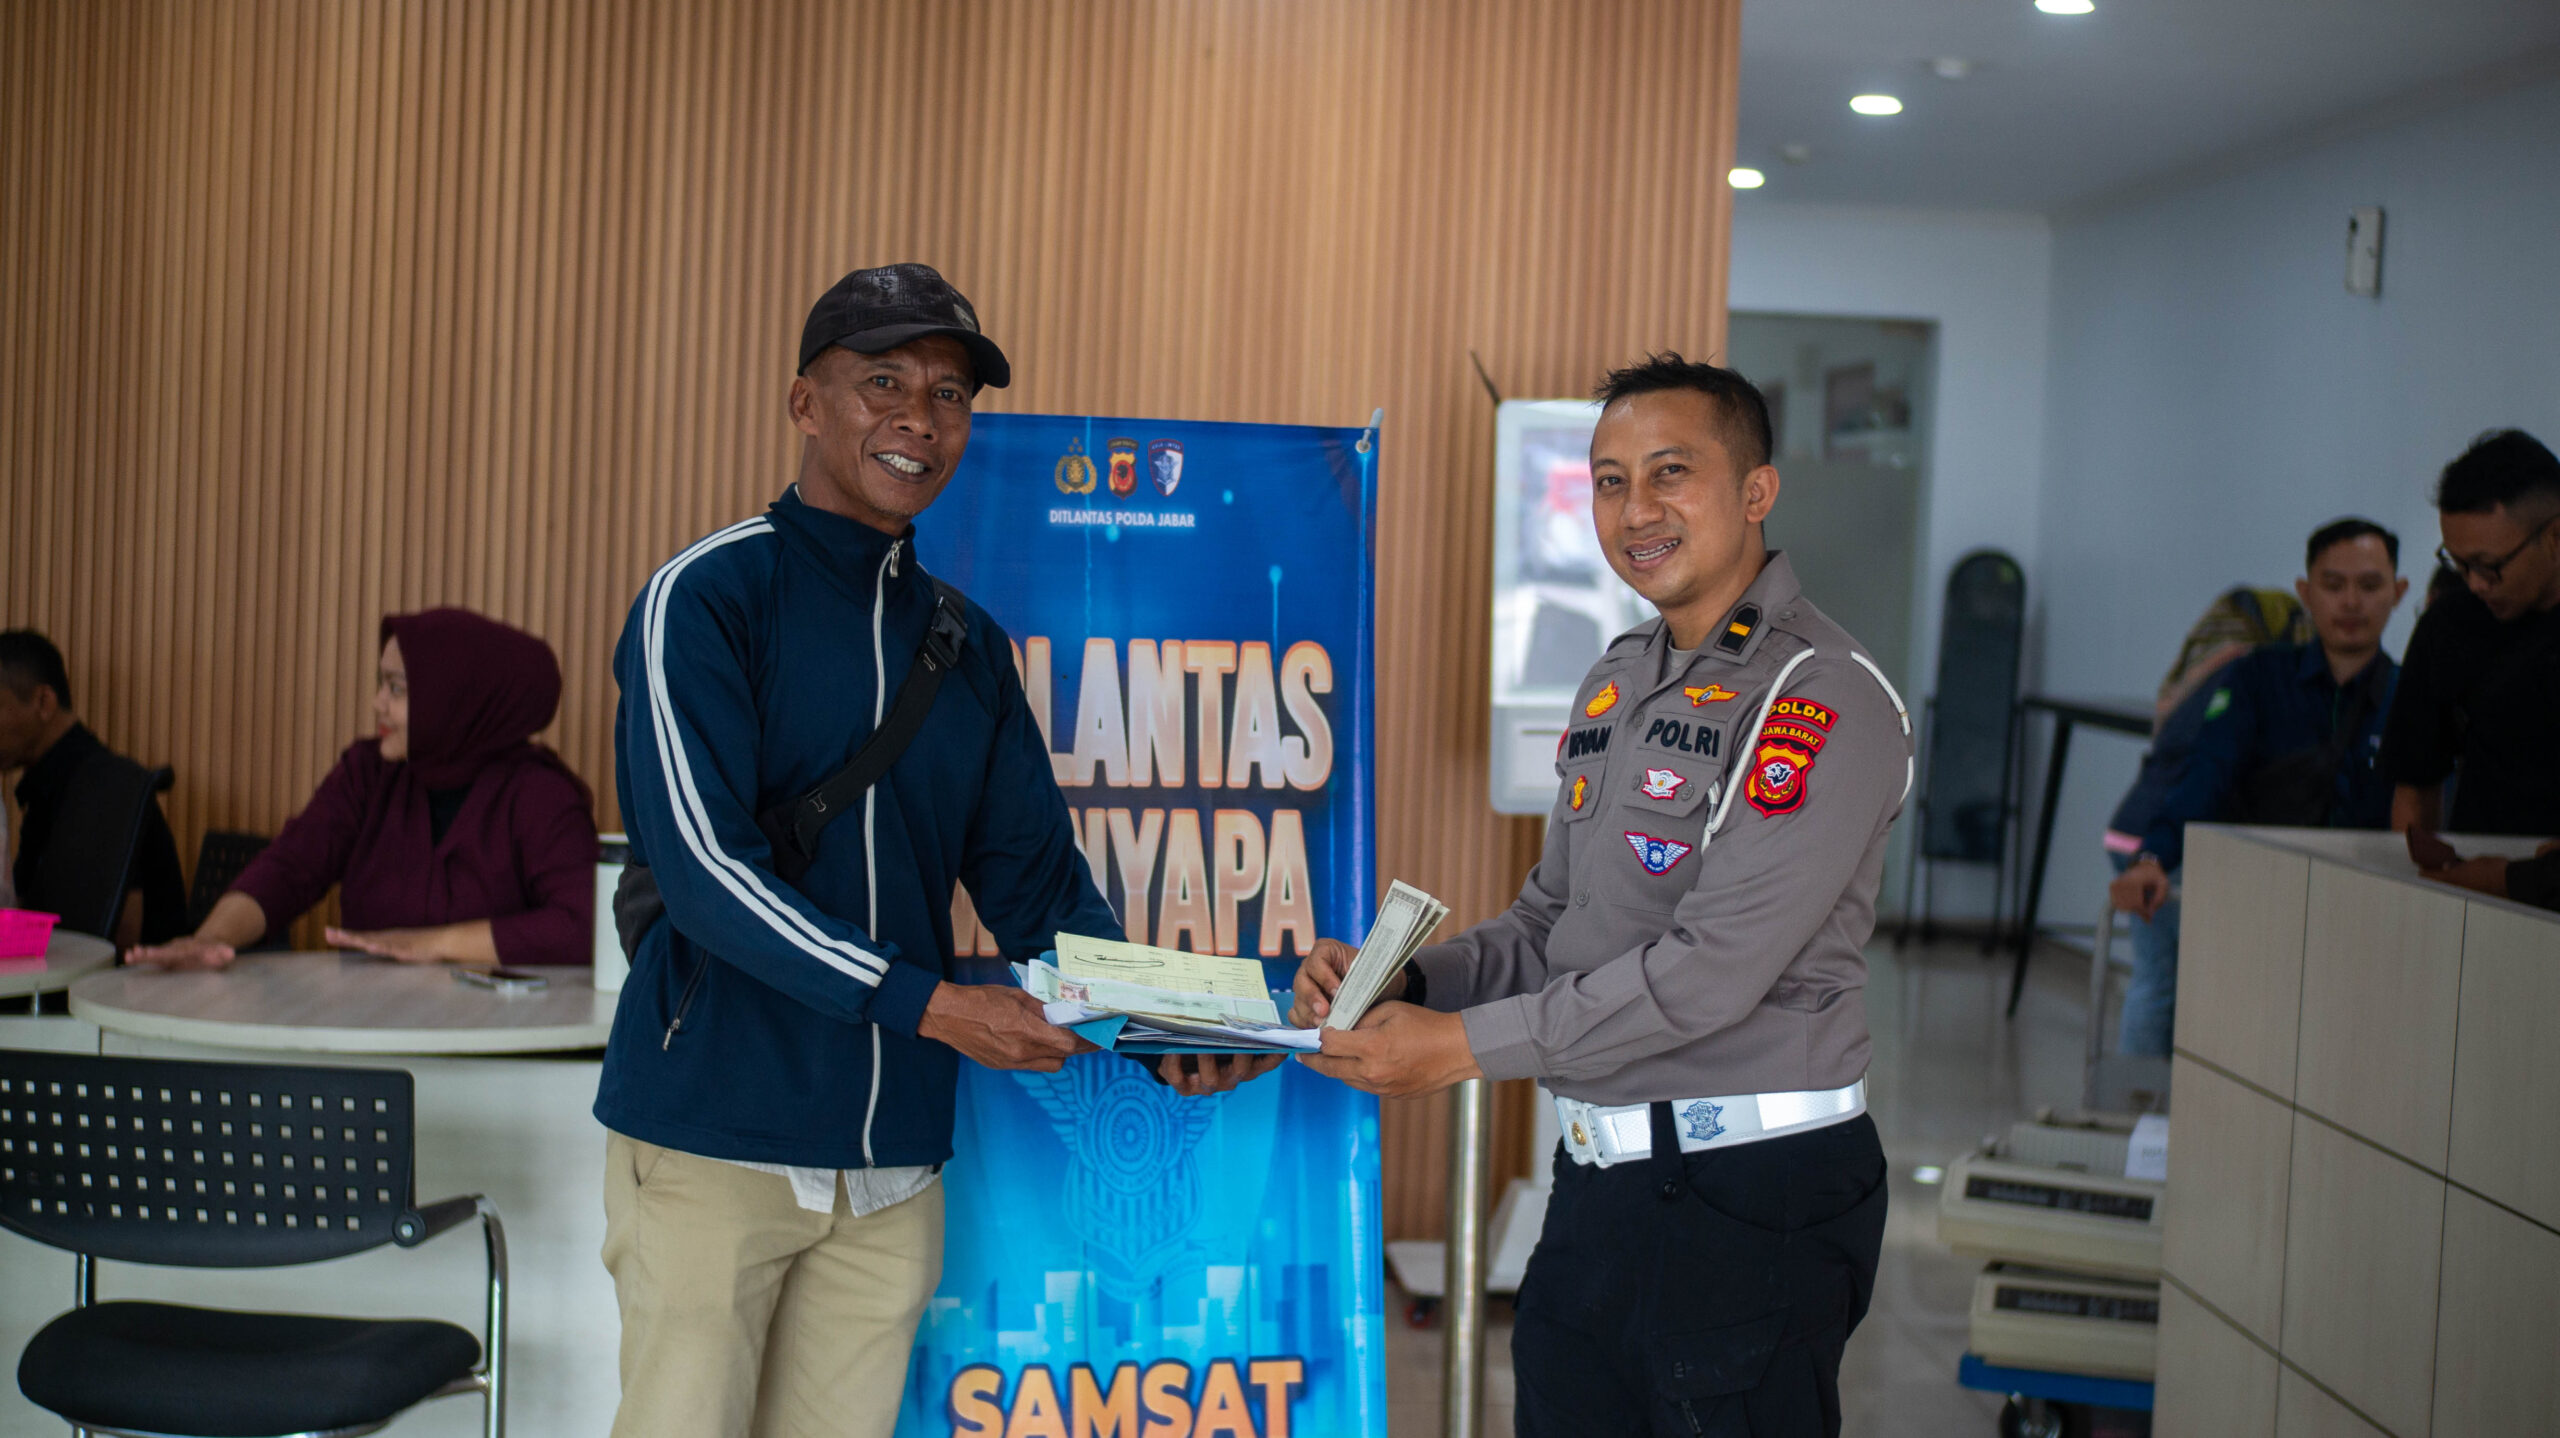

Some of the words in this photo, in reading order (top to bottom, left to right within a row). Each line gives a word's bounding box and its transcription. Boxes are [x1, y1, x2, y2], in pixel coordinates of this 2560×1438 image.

[1049, 509, 1113, 525] DITLANTAS
[1115, 511, 1155, 527] POLDA
[1157, 513, 1195, 528] JABAR
[1010, 637, 1333, 791] LANTAS
[1645, 718, 1720, 758] POLRI
[1762, 726, 1787, 736] JAWA
[1789, 727, 1820, 746] BARAT
[950, 1357, 1304, 1438] SAMSAT
